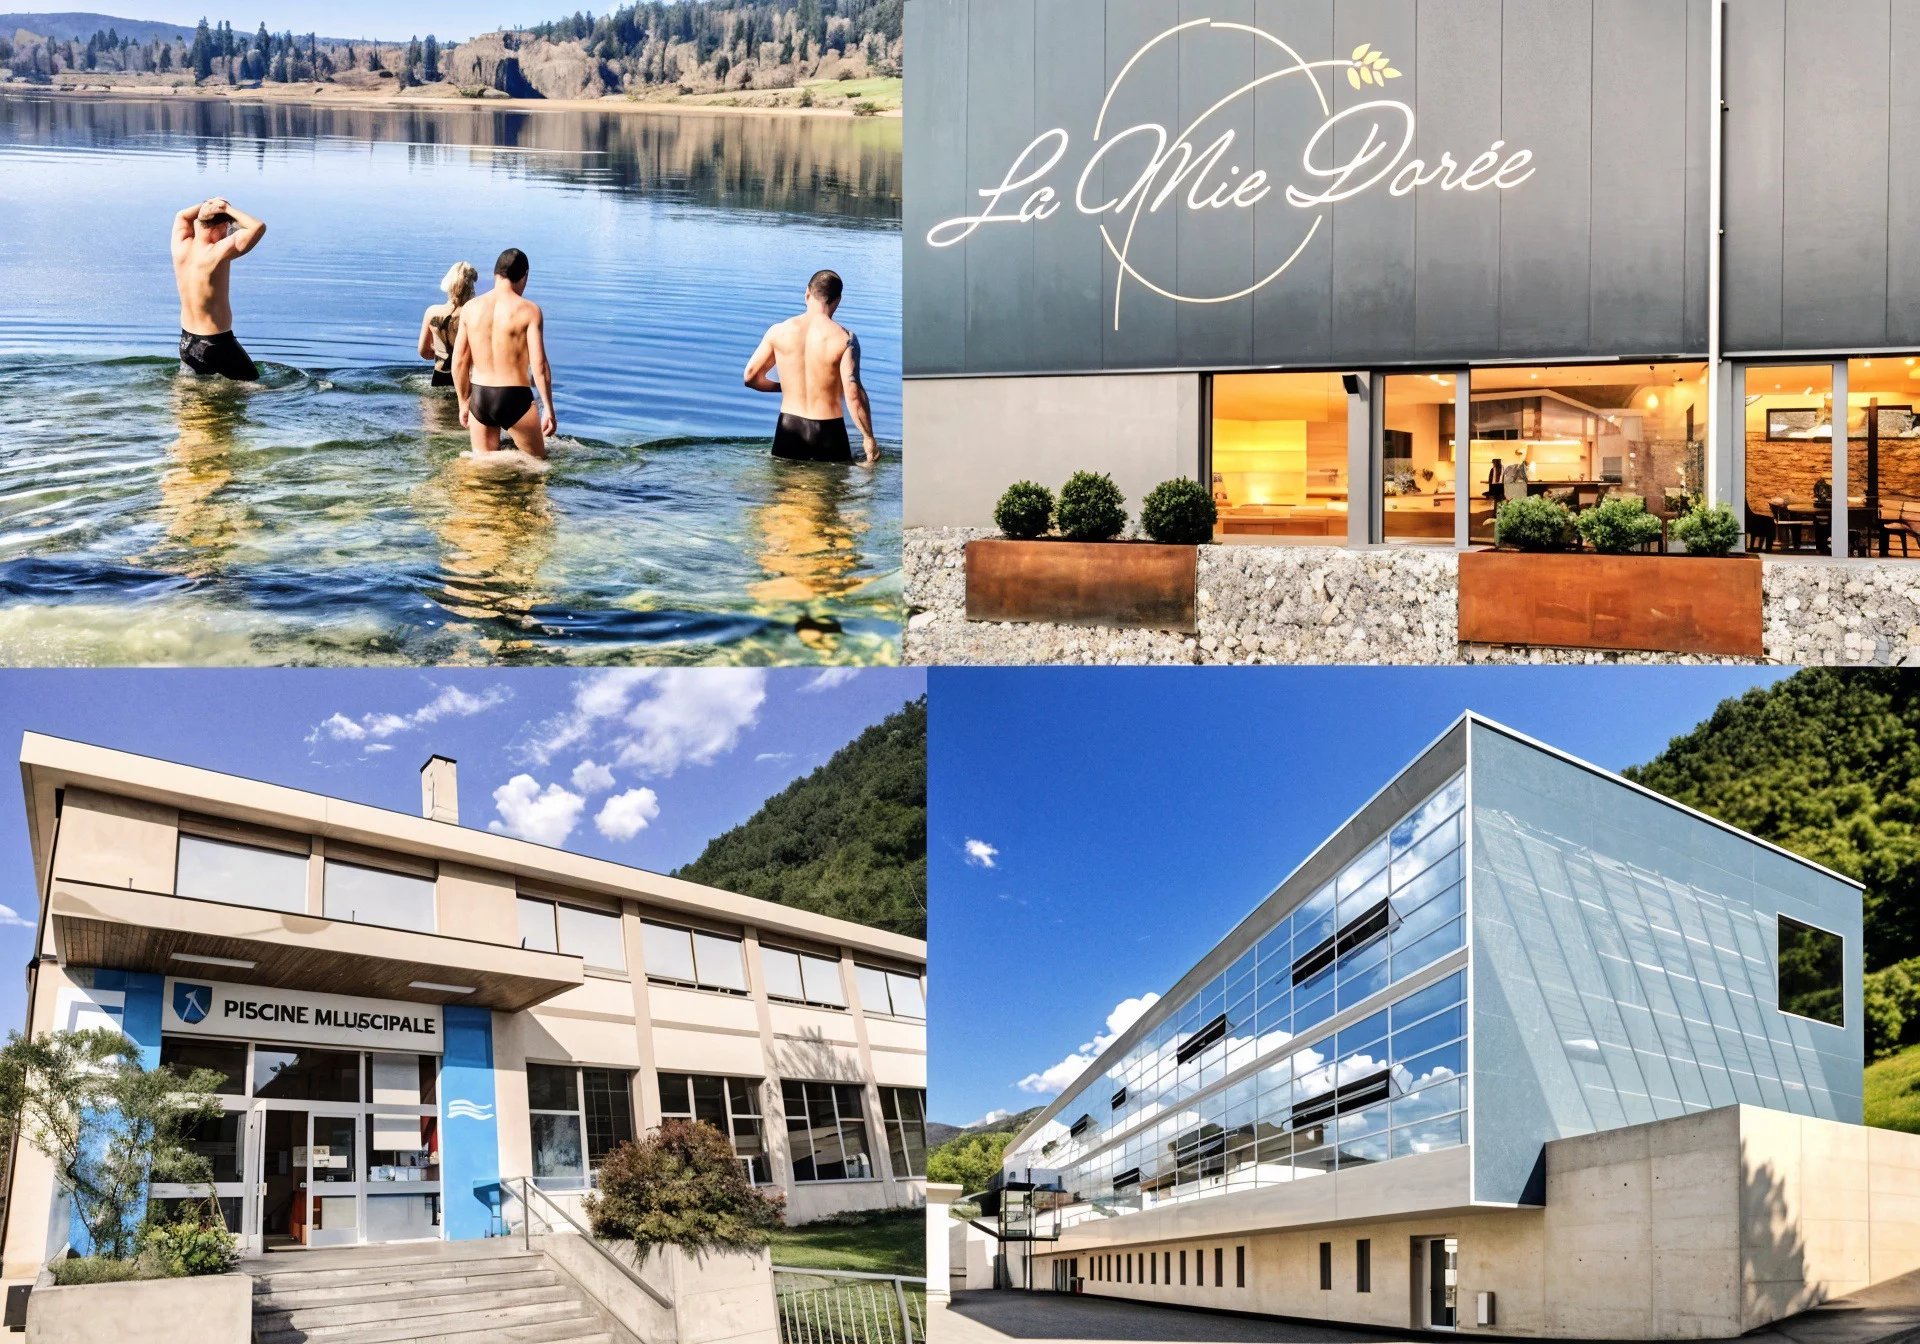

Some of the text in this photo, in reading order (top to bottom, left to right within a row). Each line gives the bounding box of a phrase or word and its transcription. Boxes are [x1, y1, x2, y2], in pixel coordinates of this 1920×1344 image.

[926, 100, 1535, 247] La Mie Dorée
[224, 1000, 309, 1024] PISCINE
